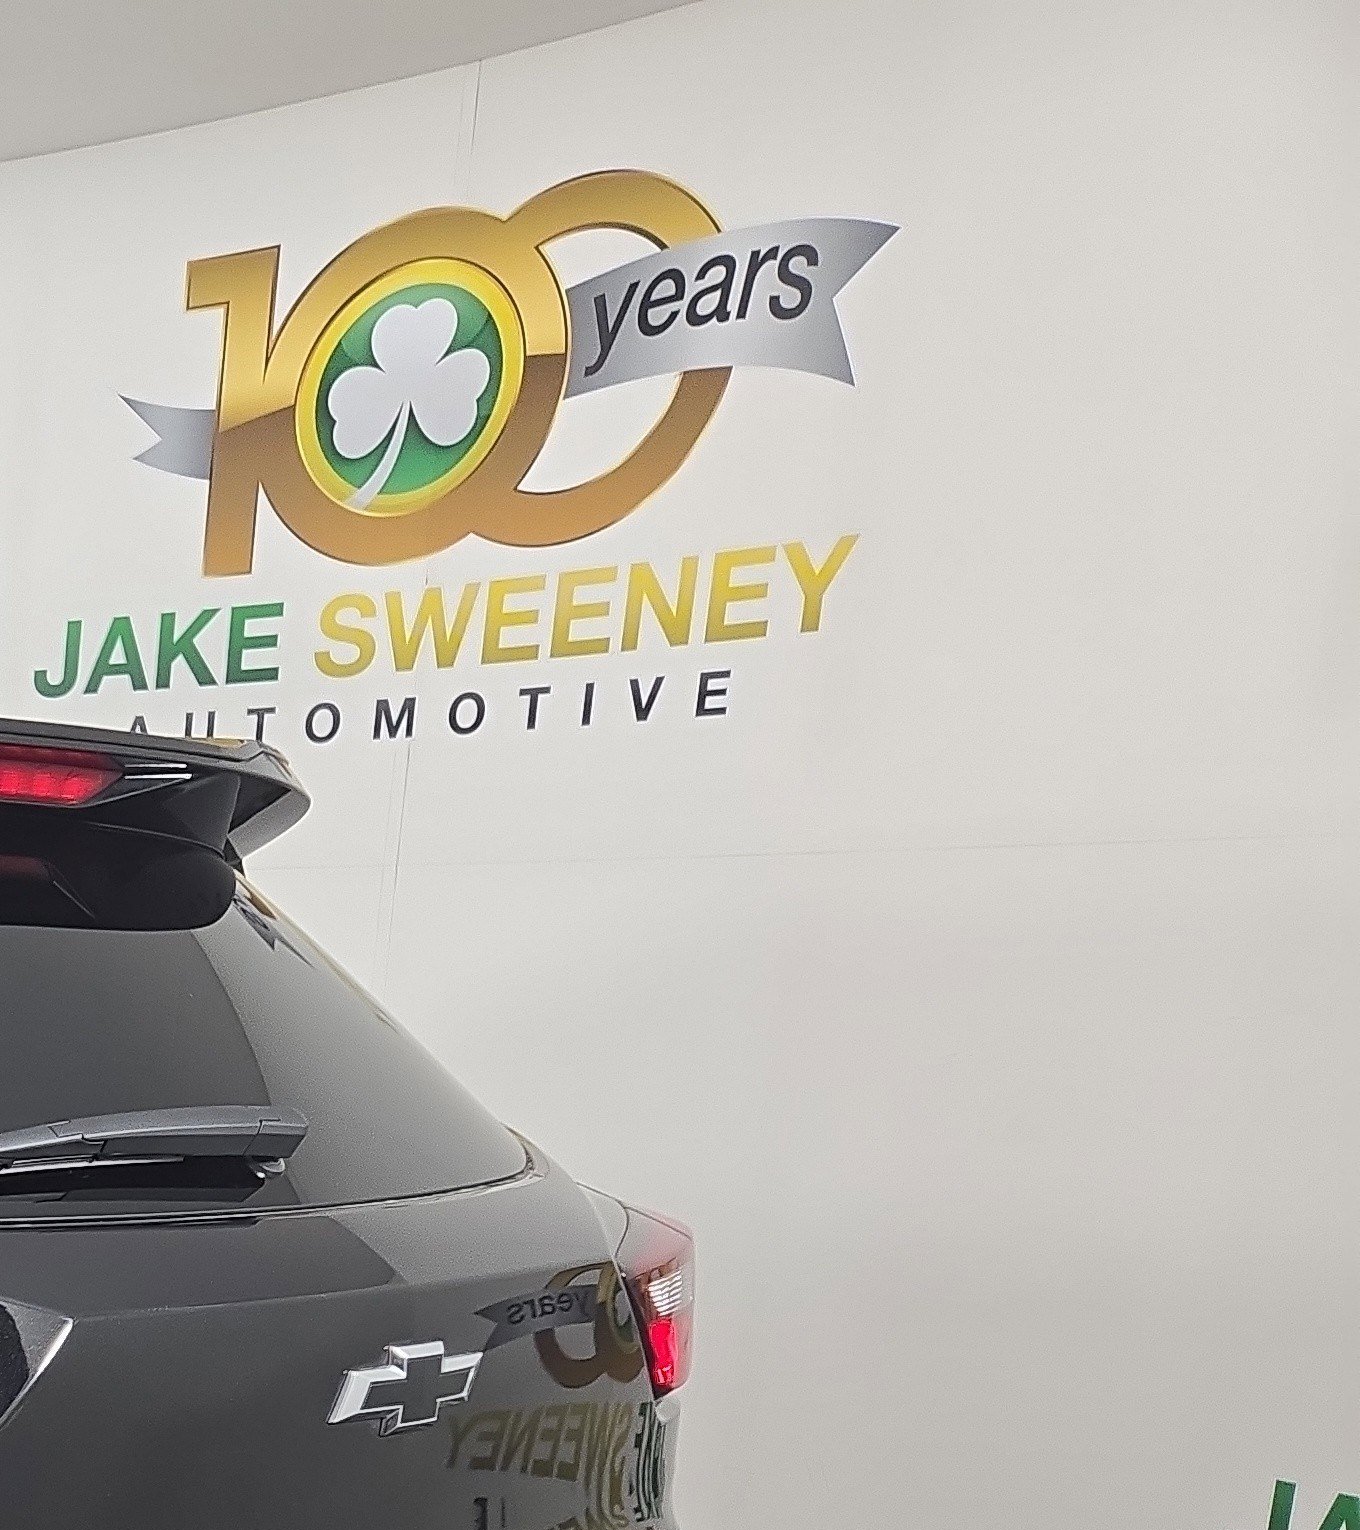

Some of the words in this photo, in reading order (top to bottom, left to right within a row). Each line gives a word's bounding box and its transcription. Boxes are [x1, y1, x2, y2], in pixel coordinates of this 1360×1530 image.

[185, 168, 733, 578] 100
[583, 240, 820, 375] years
[33, 601, 285, 699] JAKE
[313, 533, 860, 680] SWEENEY
